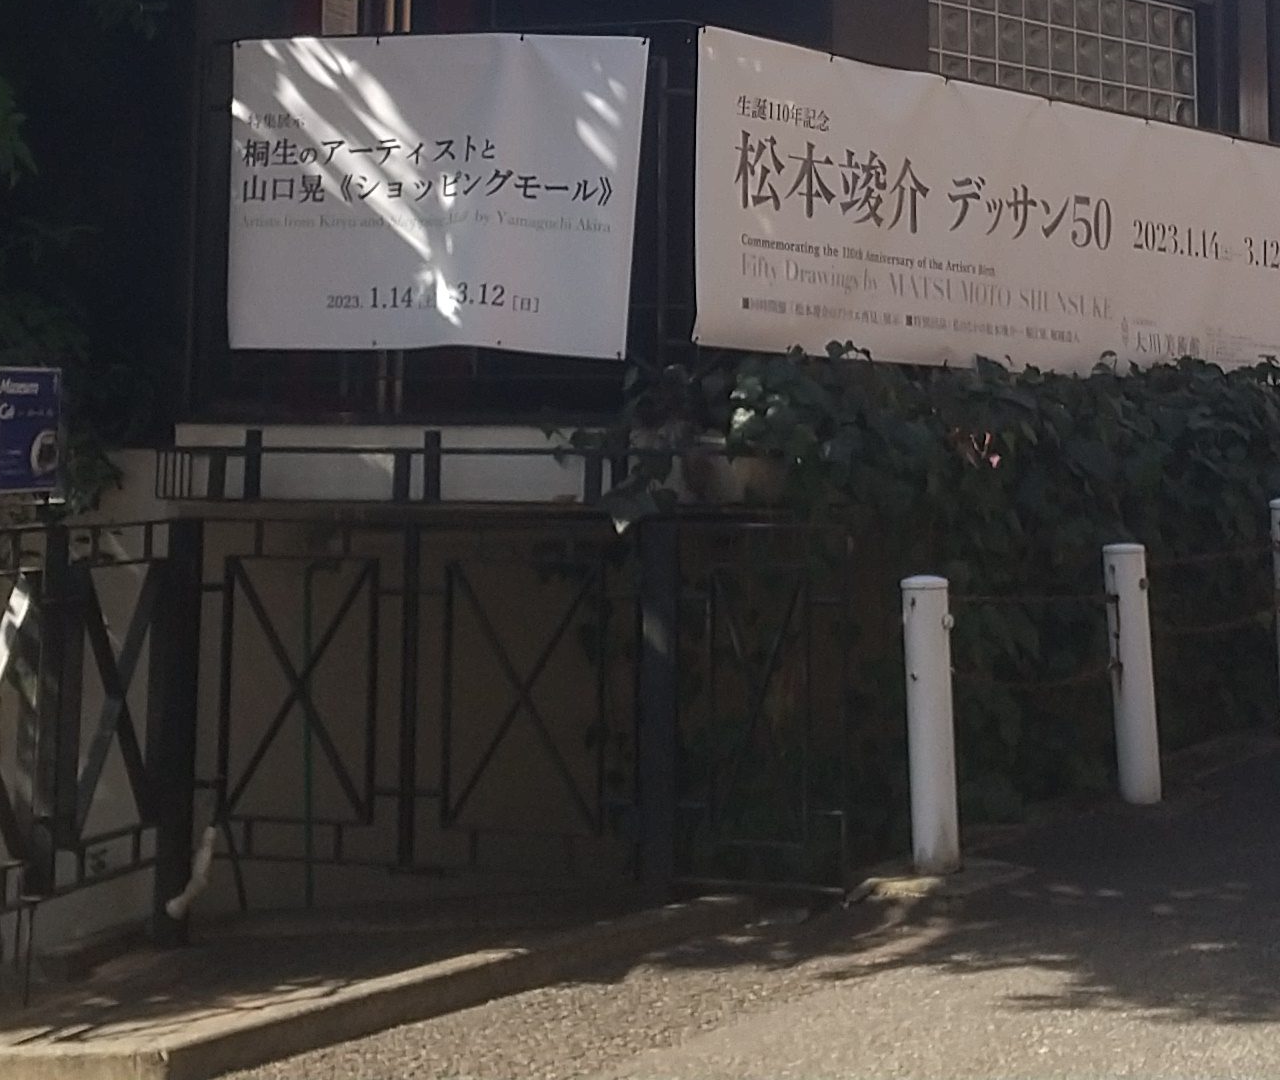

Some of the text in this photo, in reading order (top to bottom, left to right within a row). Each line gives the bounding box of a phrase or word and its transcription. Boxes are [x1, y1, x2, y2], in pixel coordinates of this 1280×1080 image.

[736, 95, 830, 132] 生誕110年記念
[243, 135, 495, 167] 桐生のアーティストと
[734, 129, 930, 234] 松本竣介
[948, 176, 1112, 251] デッサン50
[497, 210, 571, 231] Yamaguchi
[575, 217, 611, 233] Akira
[741, 233, 820, 258] Commemorating
[823, 243, 839, 258] the
[917, 256, 927, 269] of
[929, 256, 942, 270] the
[741, 252, 778, 286] Fifty
[785, 259, 859, 295] Drawings
[888, 271, 1011, 308] MATSUMOTO
[1019, 288, 1112, 320] SHUNSUKE
